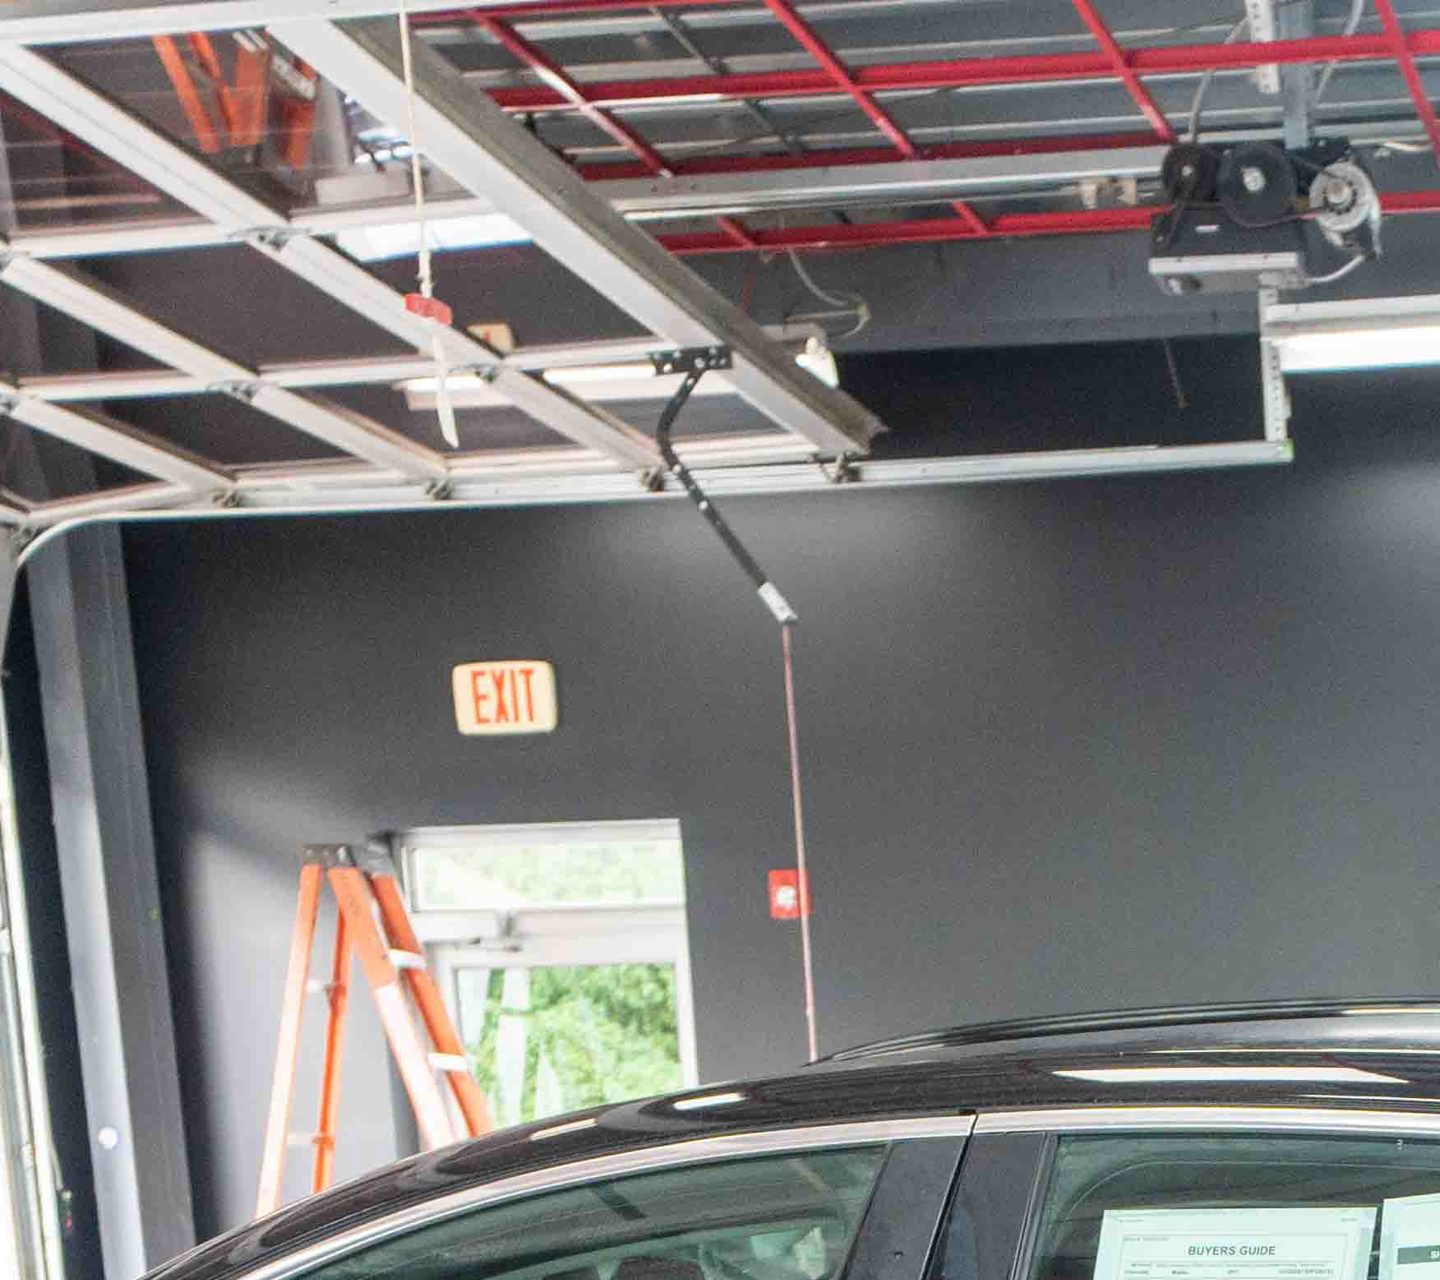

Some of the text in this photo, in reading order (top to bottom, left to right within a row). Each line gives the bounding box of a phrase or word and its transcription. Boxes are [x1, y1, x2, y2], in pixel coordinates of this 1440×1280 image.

[470, 668, 535, 724] EXIT
[1188, 1246, 1276, 1256] BUYERS GUIDE
